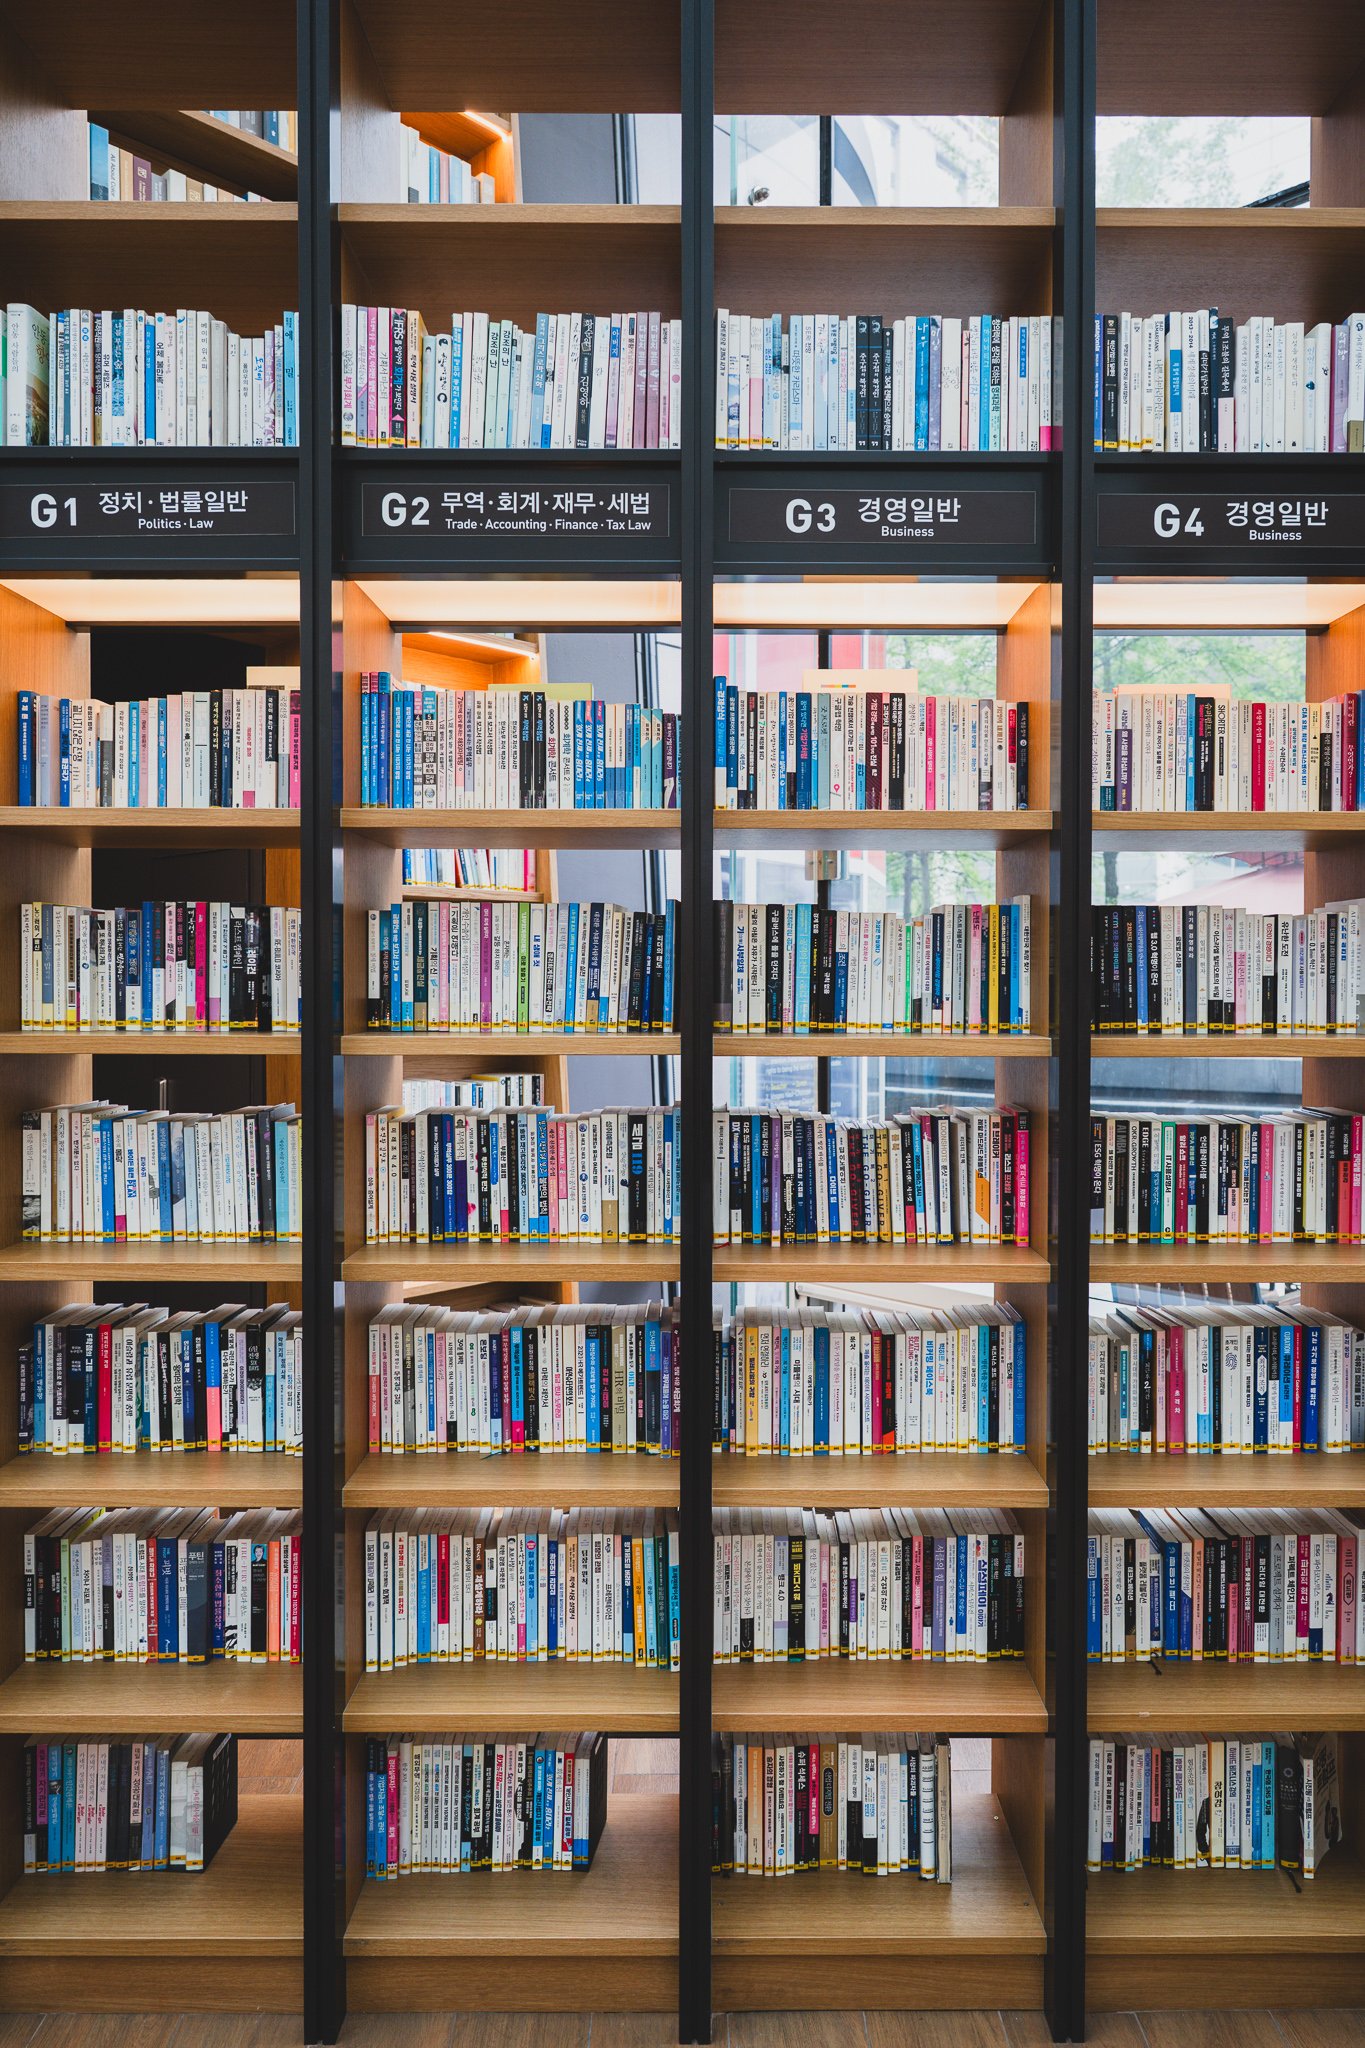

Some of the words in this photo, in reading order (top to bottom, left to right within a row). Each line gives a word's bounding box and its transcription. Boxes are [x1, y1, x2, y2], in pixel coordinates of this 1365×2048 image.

[792, 375, 800, 405] 카리스마
[30, 493, 77, 528] G1
[382, 492, 430, 527] G2
[785, 498, 836, 533] G3
[857, 497, 961, 523] 경영일반
[1153, 503, 1205, 538] G4
[1225, 501, 1329, 527] 경영일반
[628, 519, 651, 530] Law
[881, 525, 934, 537] Business
[1249, 529, 1302, 540] Business
[1217, 705, 1225, 735] SHORTER
[247, 950, 256, 975] 레이건
[732, 1121, 740, 1131] DX
[784, 1120, 792, 1128] The
[784, 1129, 792, 1137] DX
[1093, 1143, 1102, 1157] ESG
[1116, 1131, 1126, 1153] MBA
[631, 1152, 643, 1175] 119
[777, 1590, 785, 1601] 4.0
[978, 1560, 987, 1607] 삼성페이
